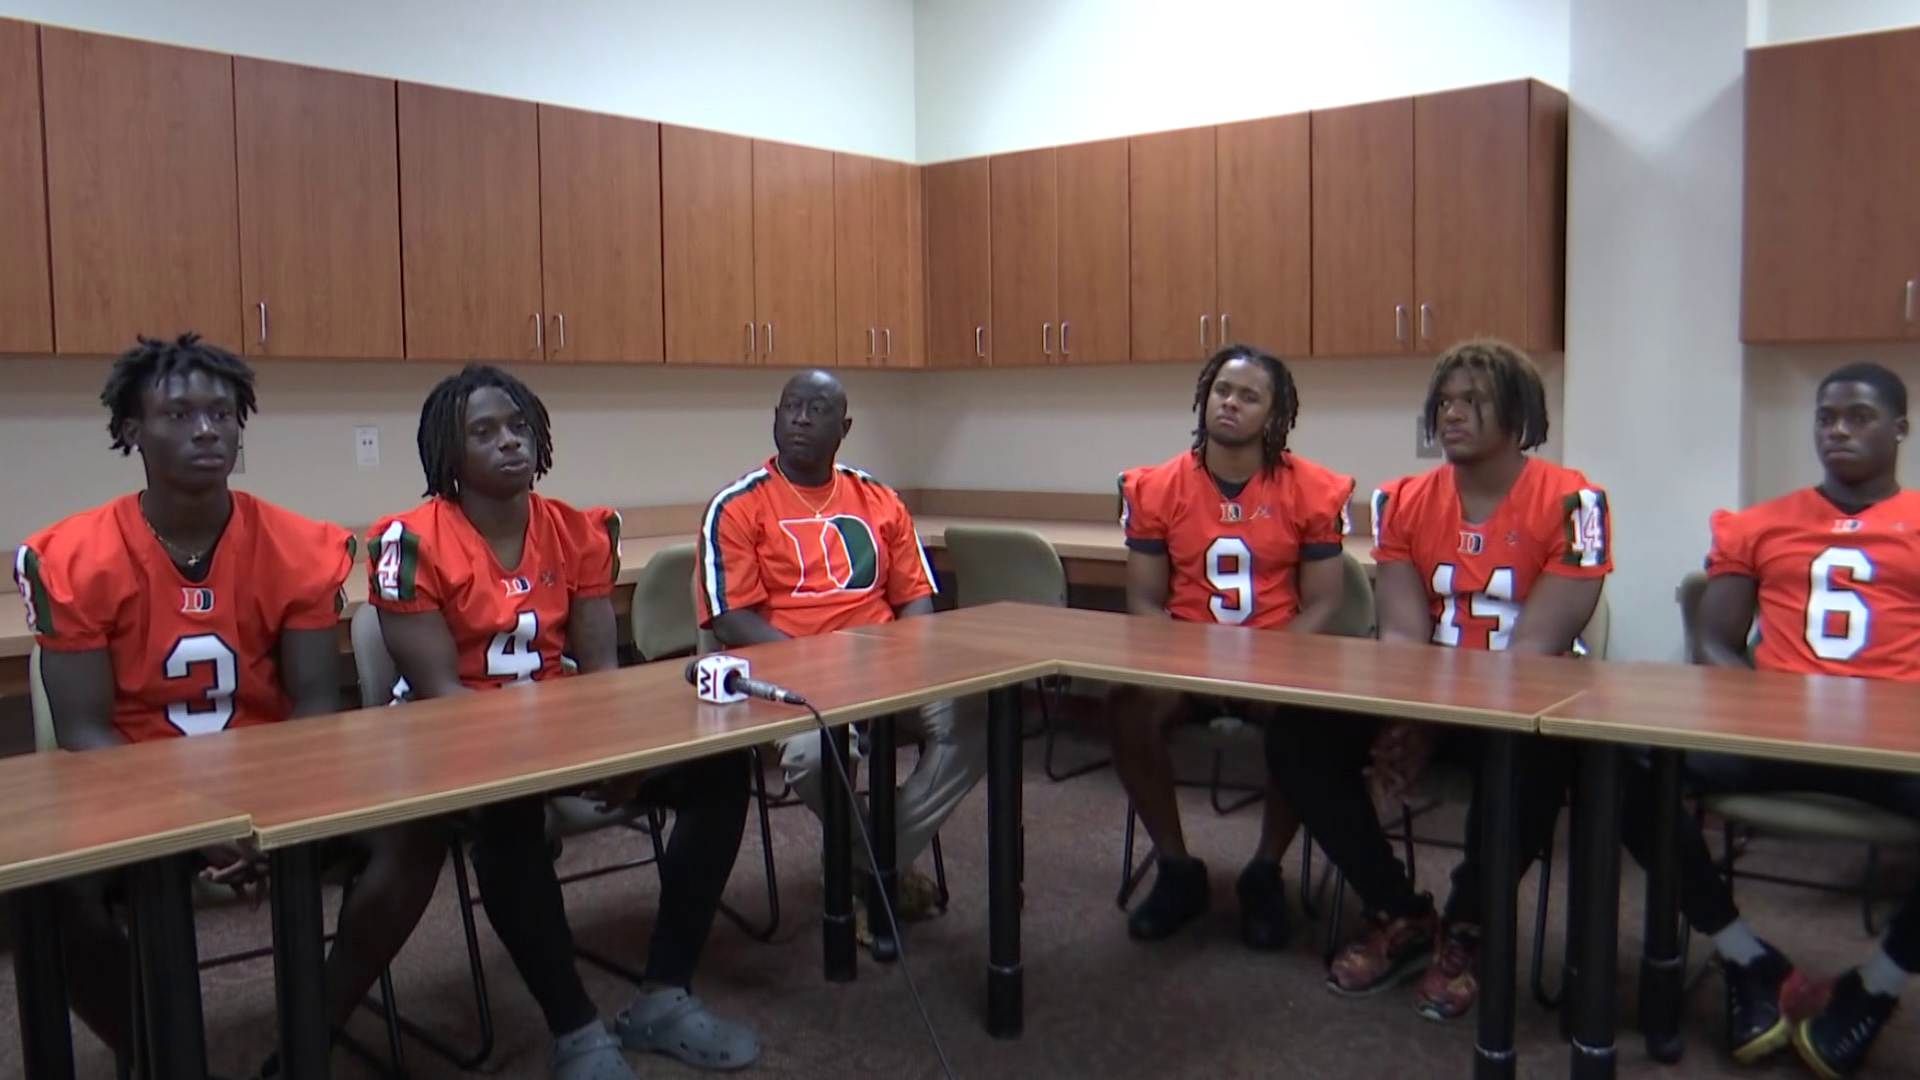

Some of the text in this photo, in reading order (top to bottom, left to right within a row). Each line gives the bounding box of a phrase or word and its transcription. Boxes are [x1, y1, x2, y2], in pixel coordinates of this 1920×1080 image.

[376, 541, 402, 589] 4
[1570, 506, 1603, 553] 14
[1204, 536, 1254, 625] 9
[1431, 563, 1521, 651] 14
[1803, 545, 1876, 662] 6
[165, 632, 238, 736] 3
[486, 610, 543, 685] 4
